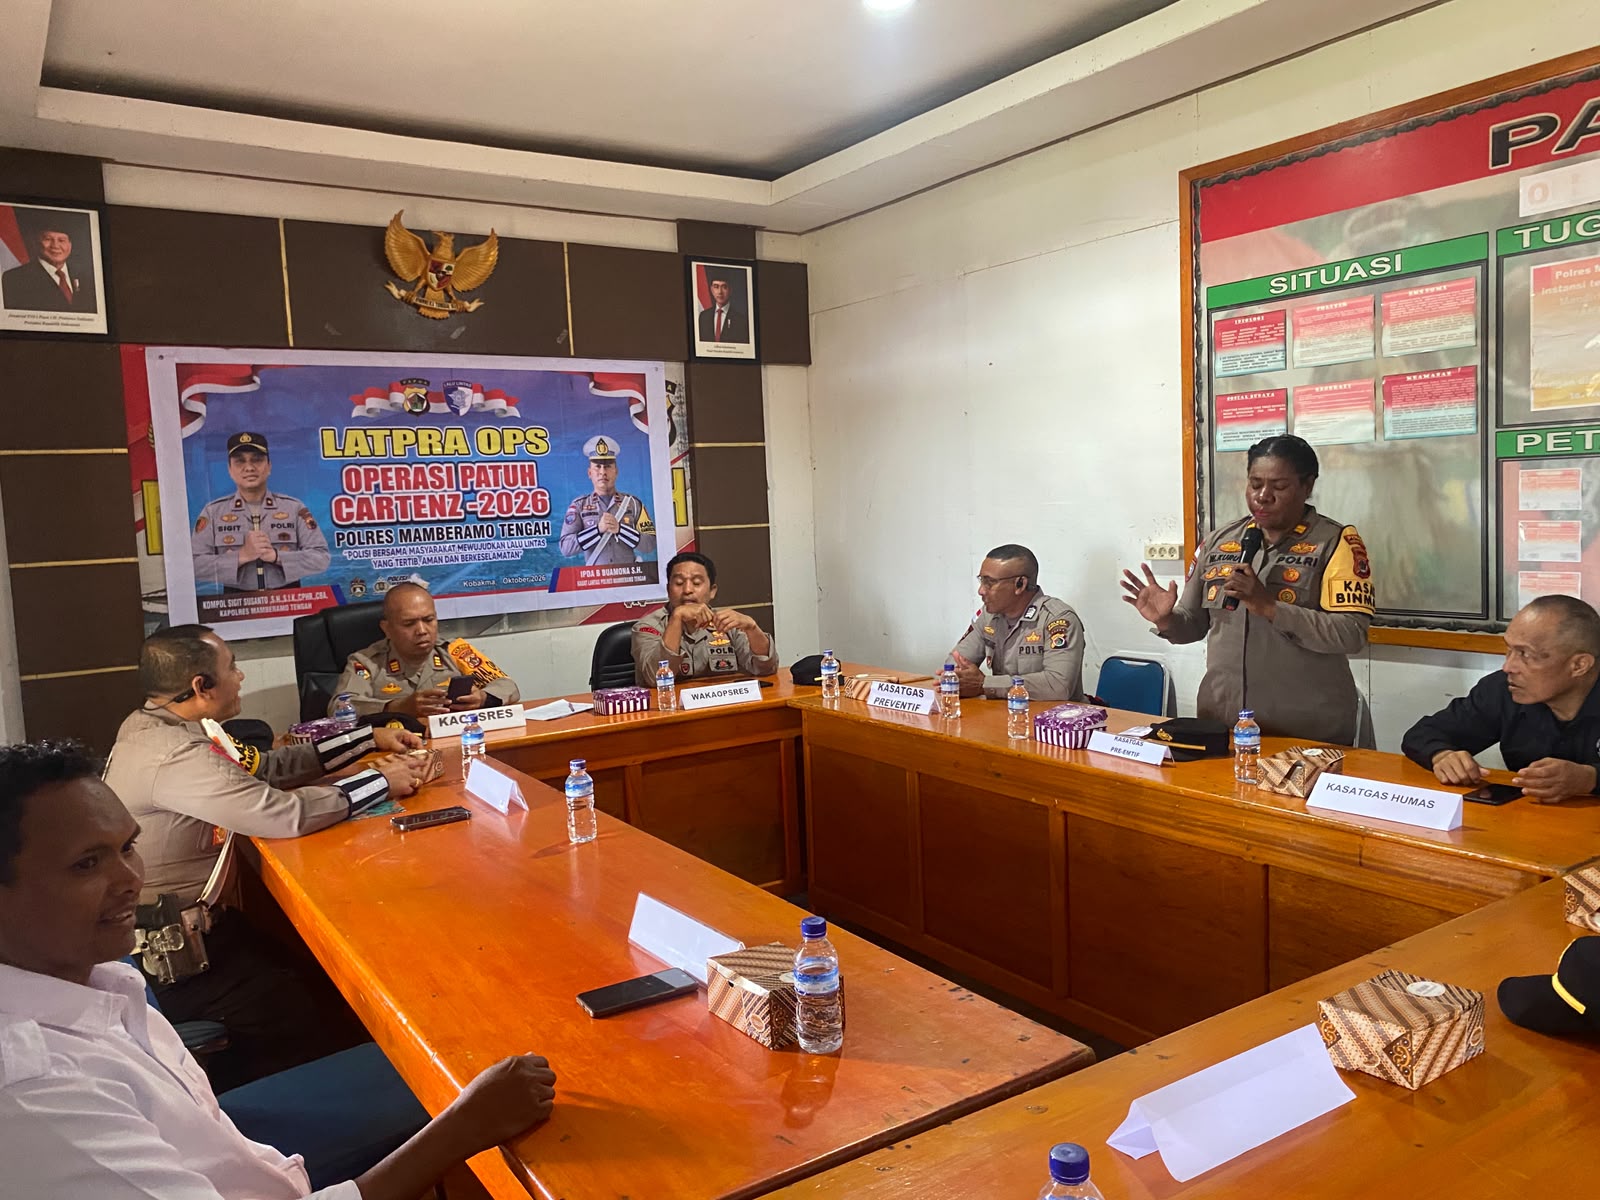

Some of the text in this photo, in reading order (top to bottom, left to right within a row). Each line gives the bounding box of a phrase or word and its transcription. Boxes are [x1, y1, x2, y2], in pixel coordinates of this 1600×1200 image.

[1269, 254, 1403, 295] SITUASI
[321, 427, 550, 458] LATPRA OPS
[343, 463, 536, 493] OPERASI PATUH
[333, 493, 463, 523] CARTENZ
[336, 522, 550, 546] POLRES MAMBERAMO TENGAH
[373, 547, 407, 557] BERSAMA
[409, 544, 455, 555] MASYARAKAT
[457, 541, 506, 552] MEWUJUDKAN
[507, 541, 523, 549] LALU
[524, 539, 546, 548] LINTAS
[373, 559, 393, 568] YANG
[422, 556, 443, 565] AMAN
[444, 555, 459, 563] DAN
[1276, 555, 1318, 568] POLRI
[580, 570, 595, 578] IPDA
[203, 599, 227, 609] KOMPOL
[228, 598, 242, 608] SIGIT
[219, 602, 313, 617] KAPOLRES MAMBERAMO TENGAH
[691, 687, 750, 701] WAKAOPSRES
[877, 682, 924, 698] KASATGAS
[873, 697, 921, 712] PREVENTIF
[1113, 735, 1144, 747] KASATGAS
[1326, 782, 1435, 809] KASATGAS HUMAS
